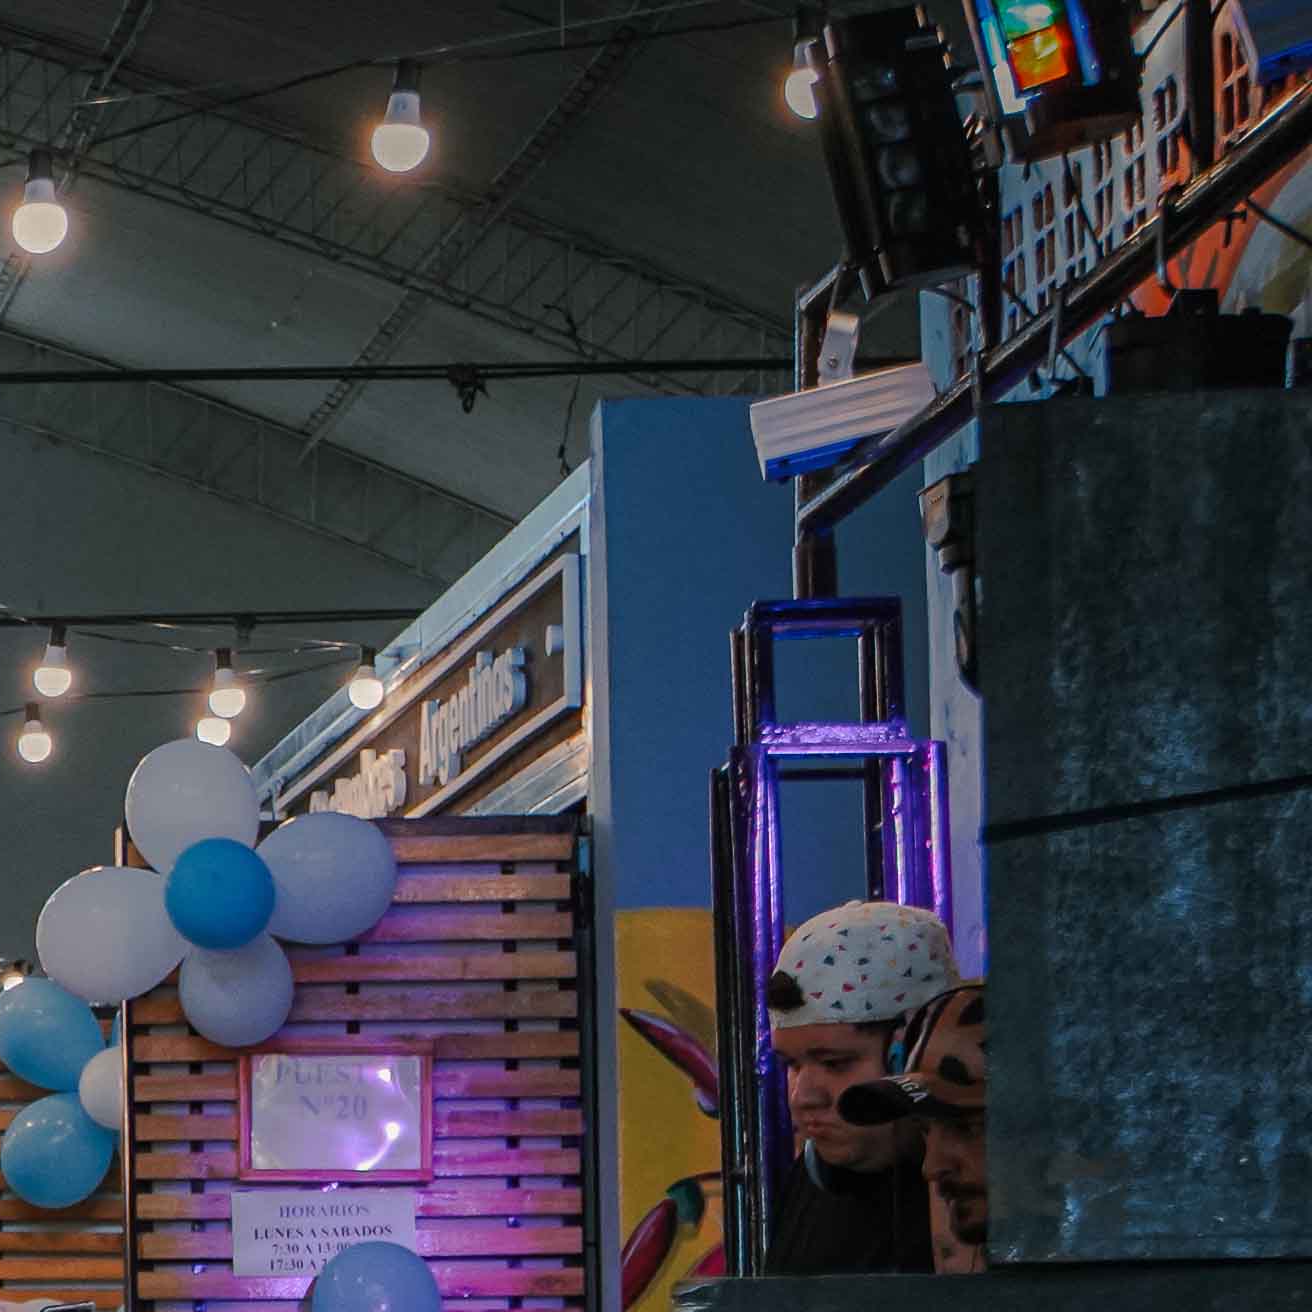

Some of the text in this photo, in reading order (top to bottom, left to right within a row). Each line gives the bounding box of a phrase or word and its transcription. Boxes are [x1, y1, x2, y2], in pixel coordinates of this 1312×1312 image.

[419, 647, 526, 784] Argentinos
[278, 1204, 371, 1219] HORARIOS
[253, 1224, 394, 1241] LUNES A SABADOS
